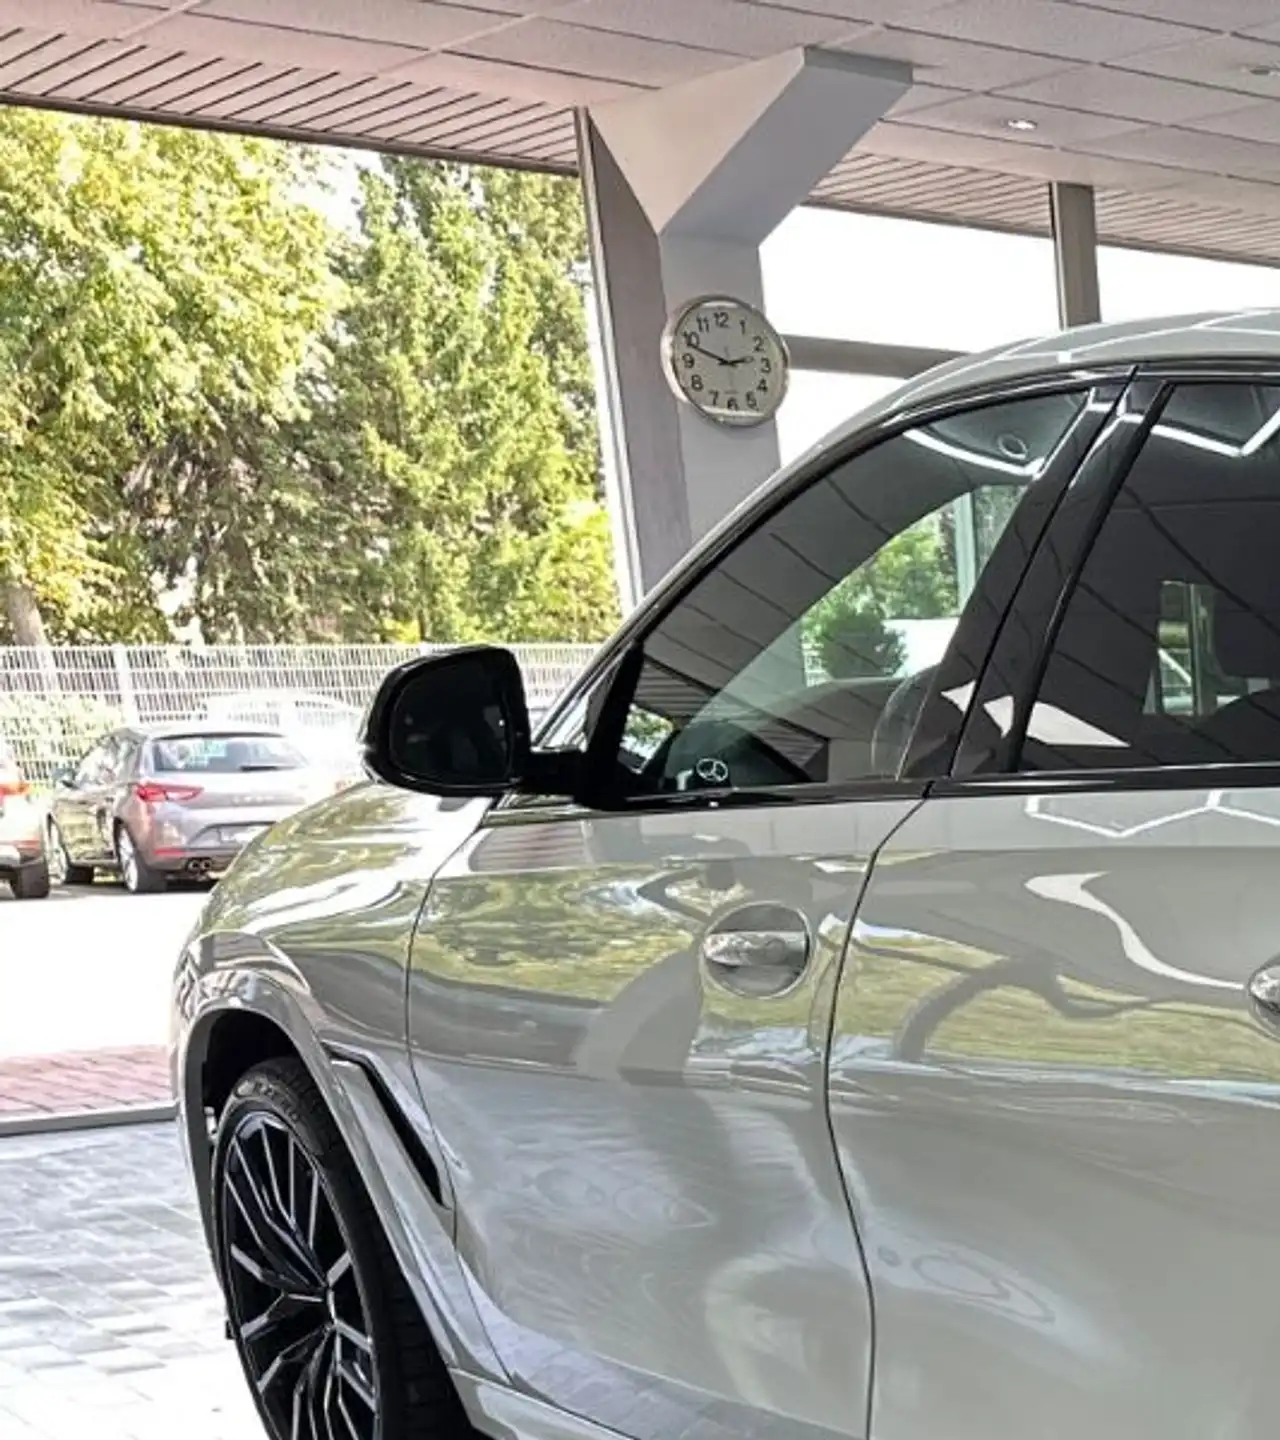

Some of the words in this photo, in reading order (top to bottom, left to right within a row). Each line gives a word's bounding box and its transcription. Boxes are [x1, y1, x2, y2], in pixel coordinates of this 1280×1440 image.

[713, 311, 730, 329] 12
[752, 336, 765, 352] 2
[682, 353, 695, 368] 9
[761, 357, 772, 373] 3
[691, 374, 703, 391] 8
[757, 378, 768, 393] 4
[708, 389, 719, 406] 7
